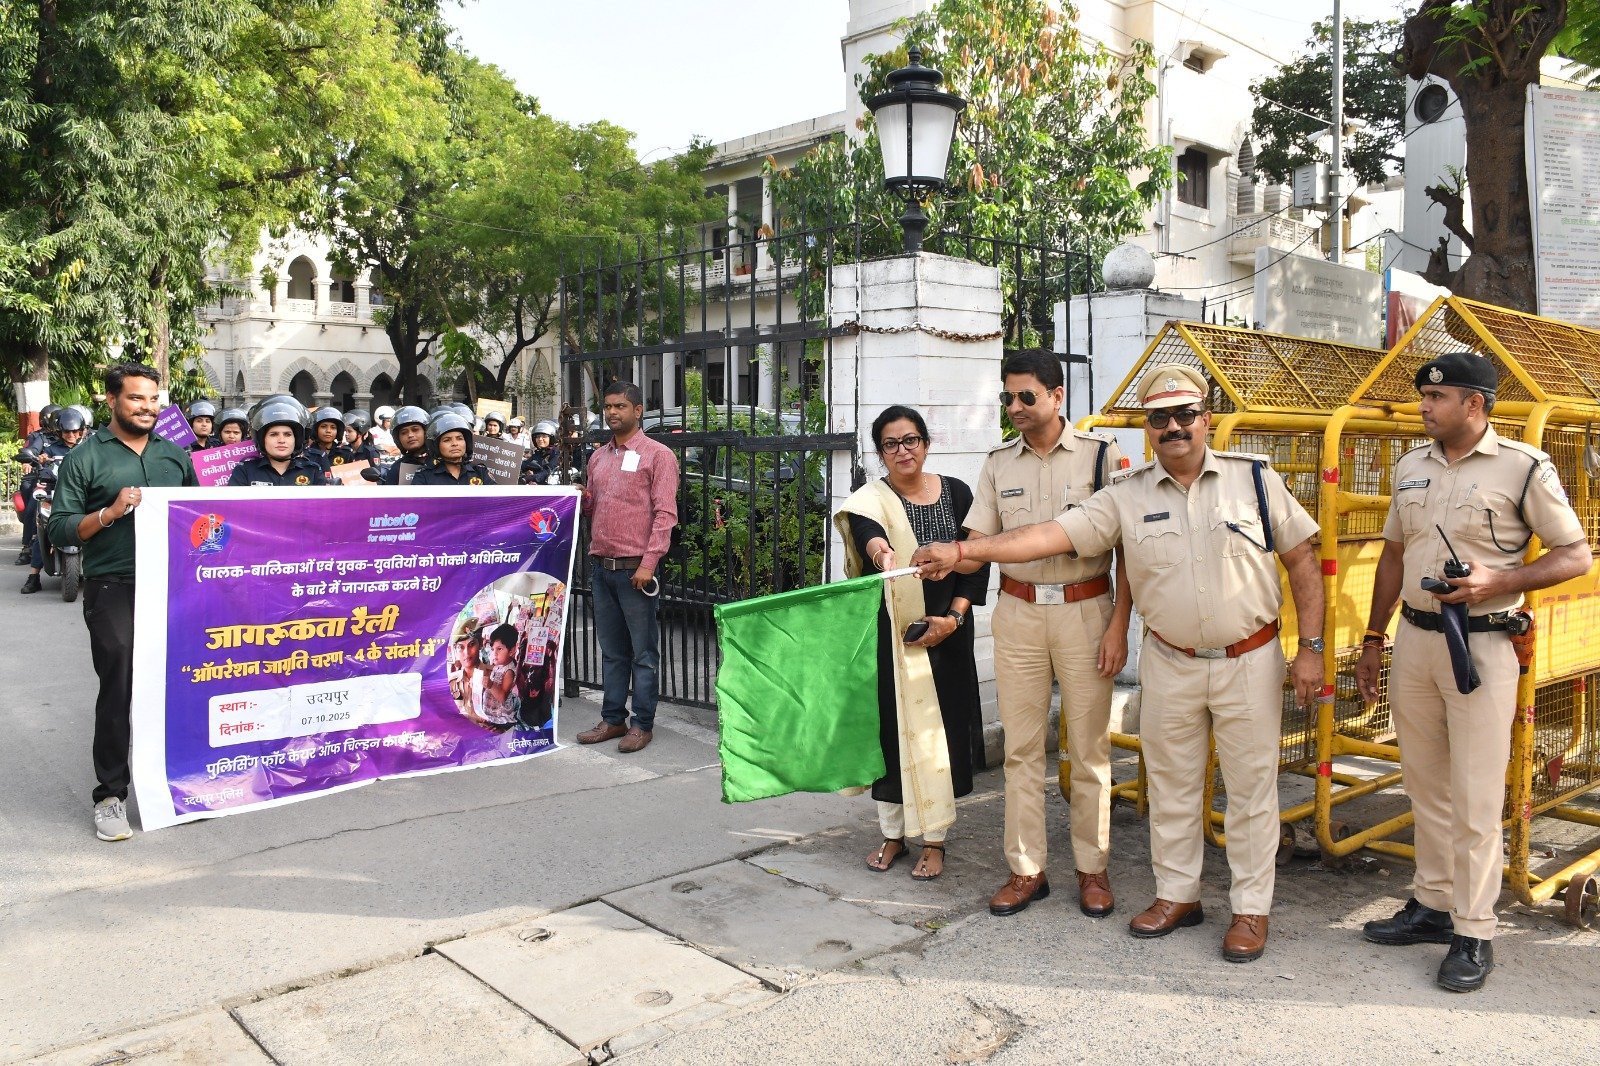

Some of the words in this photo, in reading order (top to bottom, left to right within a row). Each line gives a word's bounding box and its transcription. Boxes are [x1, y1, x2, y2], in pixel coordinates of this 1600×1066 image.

[369, 513, 406, 527] unicef
[316, 558, 335, 572] एवं
[418, 553, 434, 568] को
[469, 550, 521, 565] अधिनियम
[291, 583, 304, 597] के
[306, 580, 328, 596] बारे
[328, 579, 342, 594] में
[392, 577, 420, 591] करने
[205, 617, 348, 649] जागरूकता
[350, 604, 400, 636] रैली
[311, 650, 344, 668] चरण
[366, 641, 382, 660] के
[306, 689, 350, 706] उदयपुर
[301, 711, 351, 726] 07.10.2025
